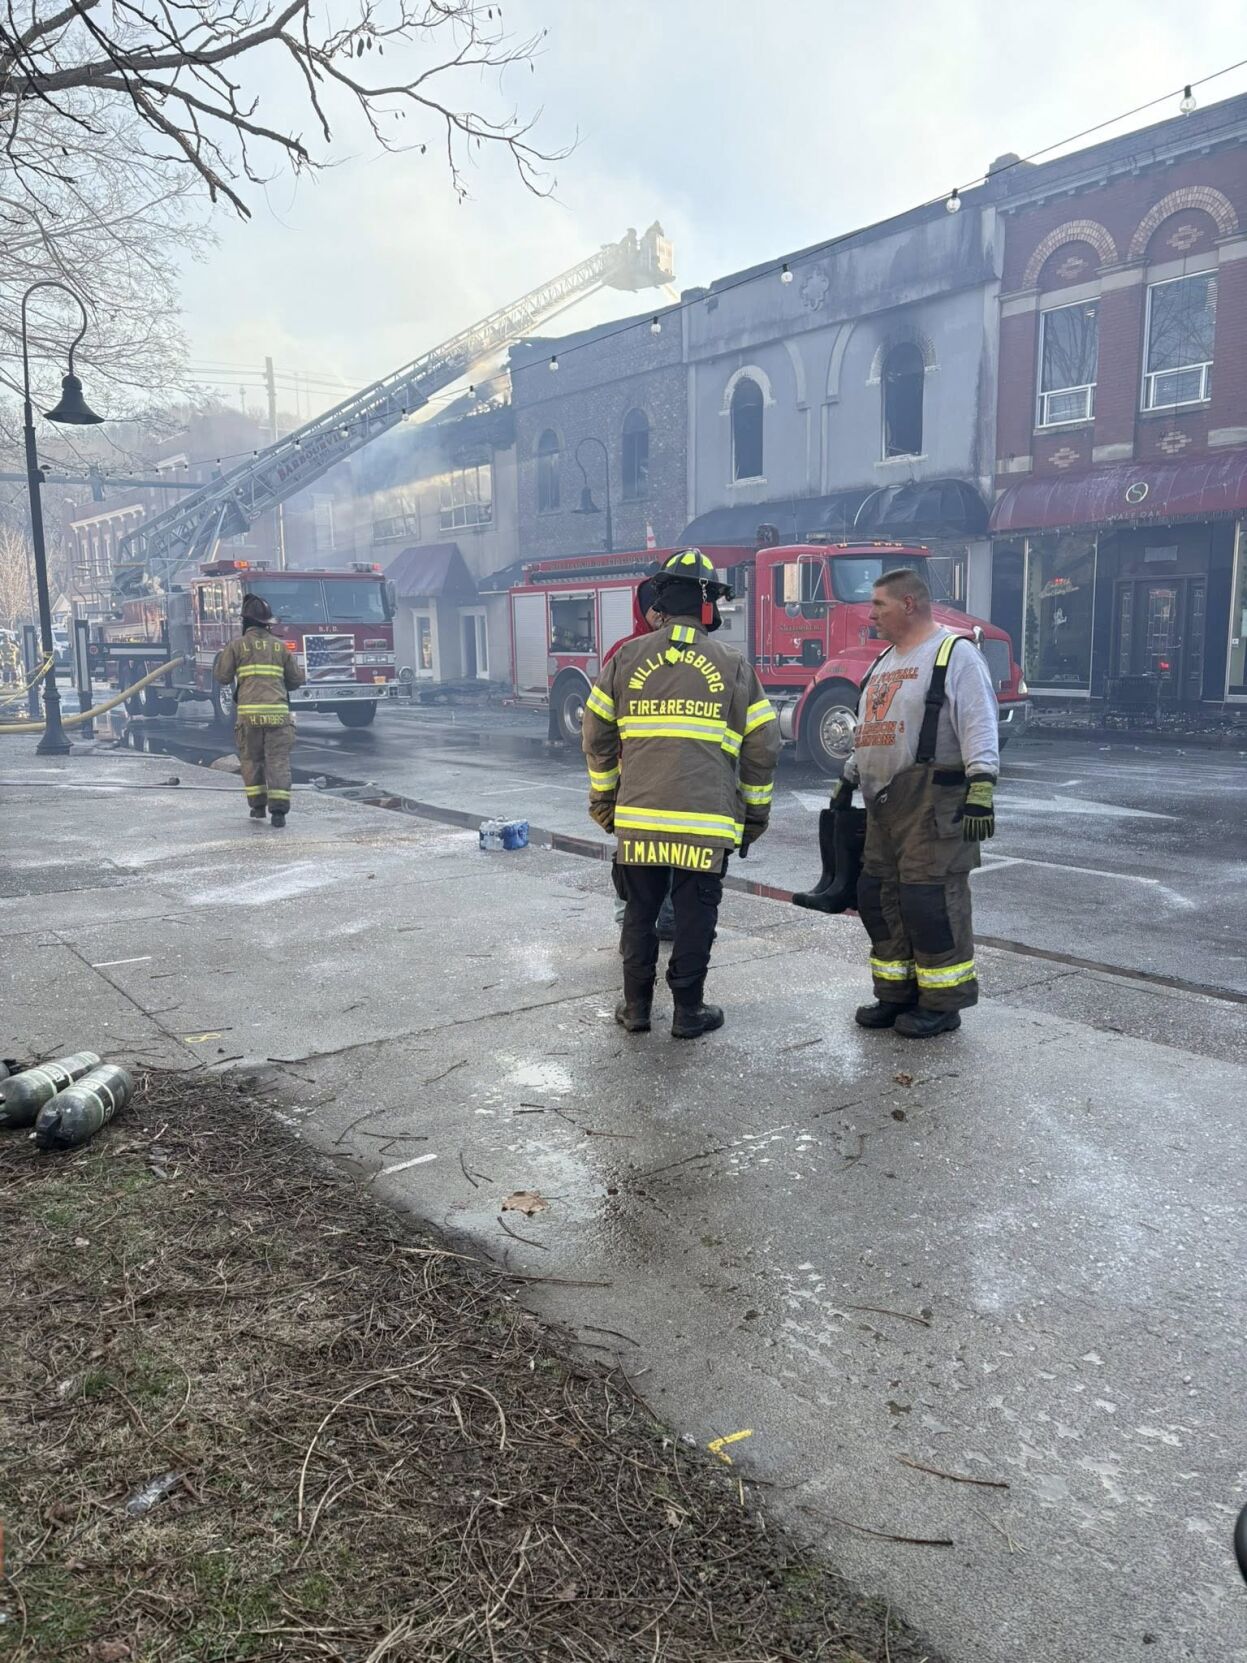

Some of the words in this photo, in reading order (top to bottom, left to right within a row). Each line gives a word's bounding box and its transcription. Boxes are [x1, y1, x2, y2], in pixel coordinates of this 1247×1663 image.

[277, 426, 357, 480] BARBOURVILE
[628, 649, 725, 694] WILLISBURG
[629, 699, 723, 719] FIRE&RESCUE
[623, 840, 714, 870] T.MANNING
